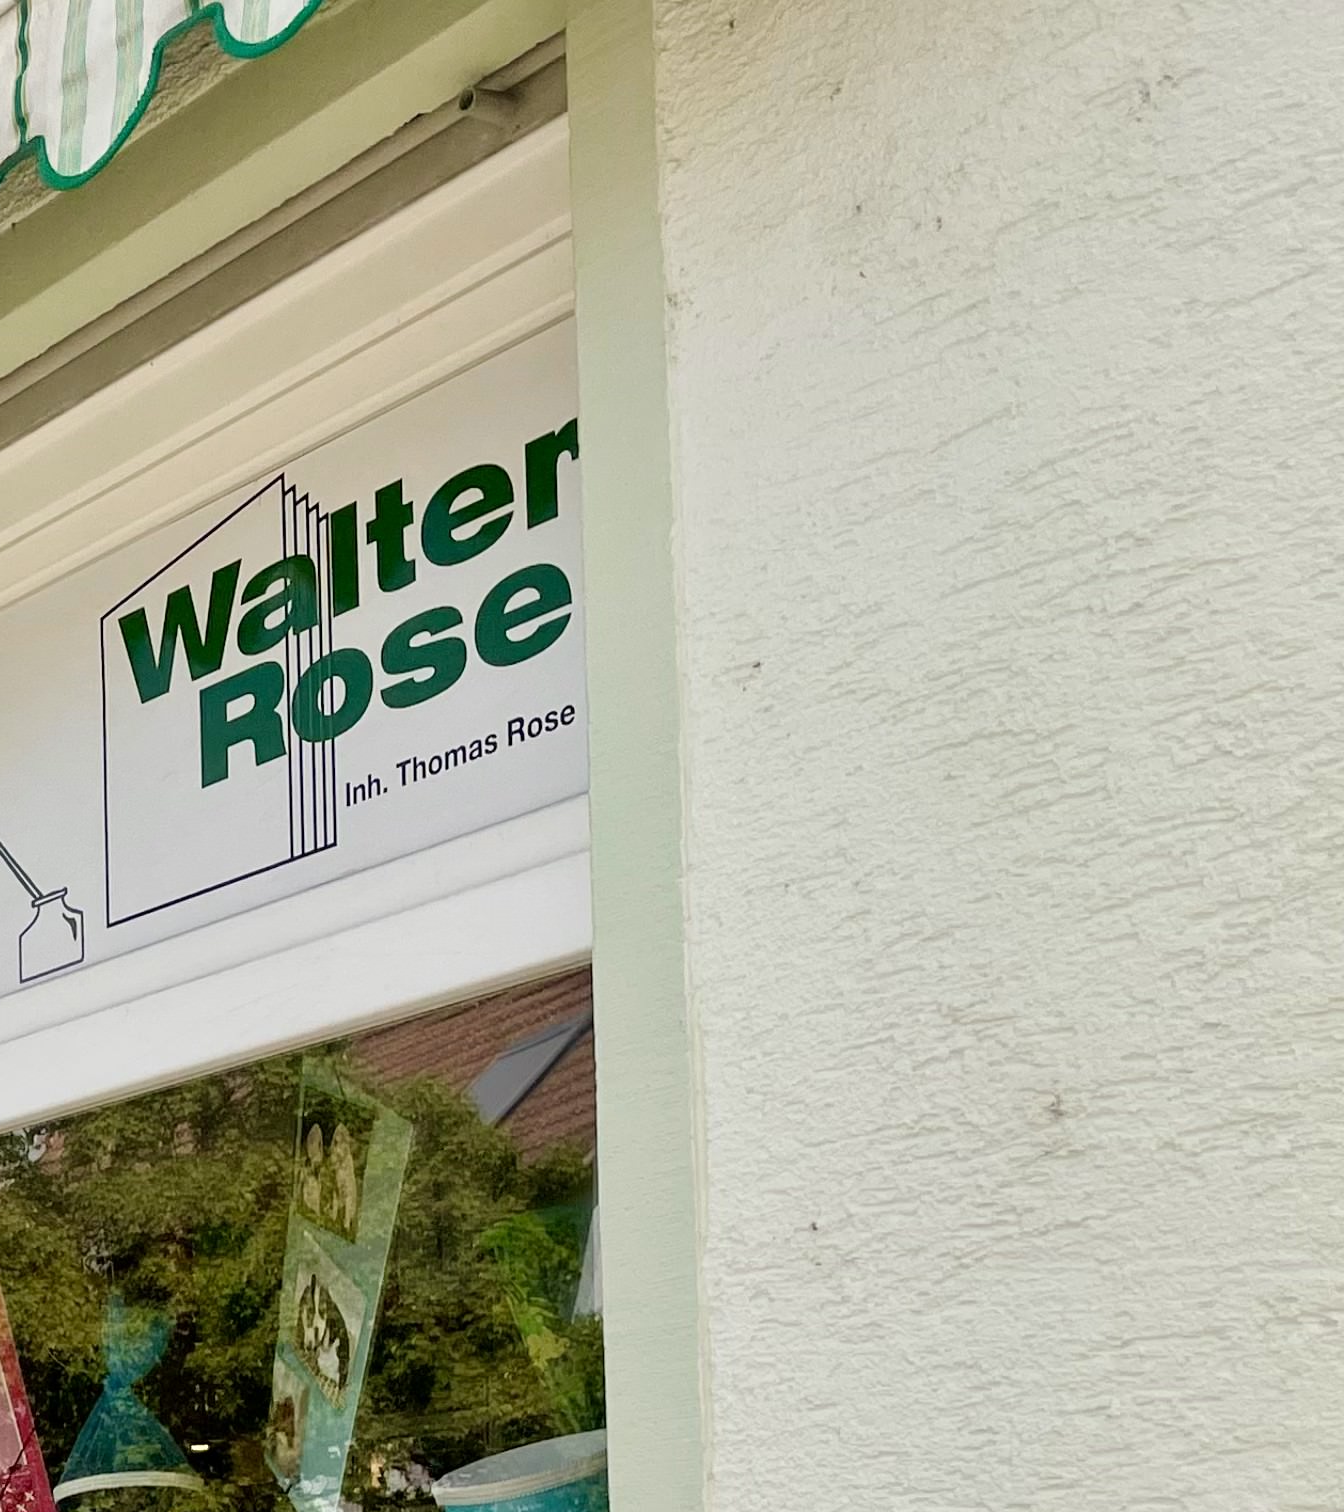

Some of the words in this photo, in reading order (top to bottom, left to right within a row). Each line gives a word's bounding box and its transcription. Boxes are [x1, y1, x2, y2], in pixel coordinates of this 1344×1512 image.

[118, 418, 579, 704] Walter
[199, 563, 572, 788] Rose
[345, 774, 388, 807] Inh.
[396, 730, 499, 788] Thomas
[506, 704, 577, 747] Rose
